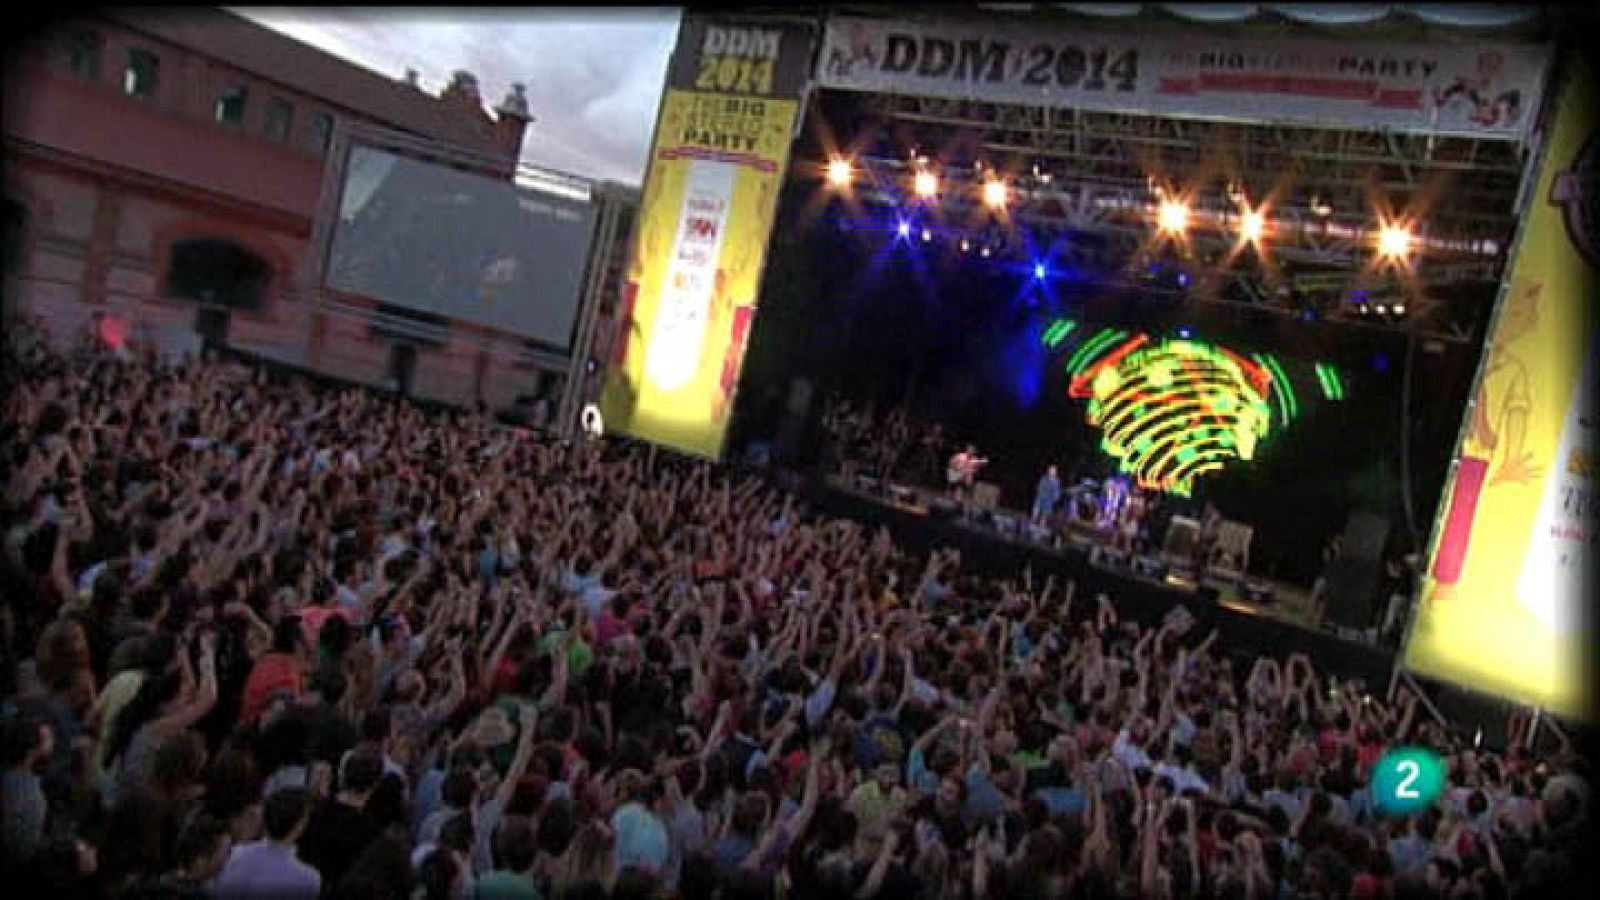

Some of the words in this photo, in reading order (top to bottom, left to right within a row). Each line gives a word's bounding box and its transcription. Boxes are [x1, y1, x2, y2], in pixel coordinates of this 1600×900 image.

[703, 27, 781, 58] DDM
[695, 57, 774, 92] 2014
[880, 33, 1010, 82] DDM
[1021, 46, 1140, 92] 2014
[1338, 55, 1438, 79] PARTY
[683, 129, 760, 152] PARTY
